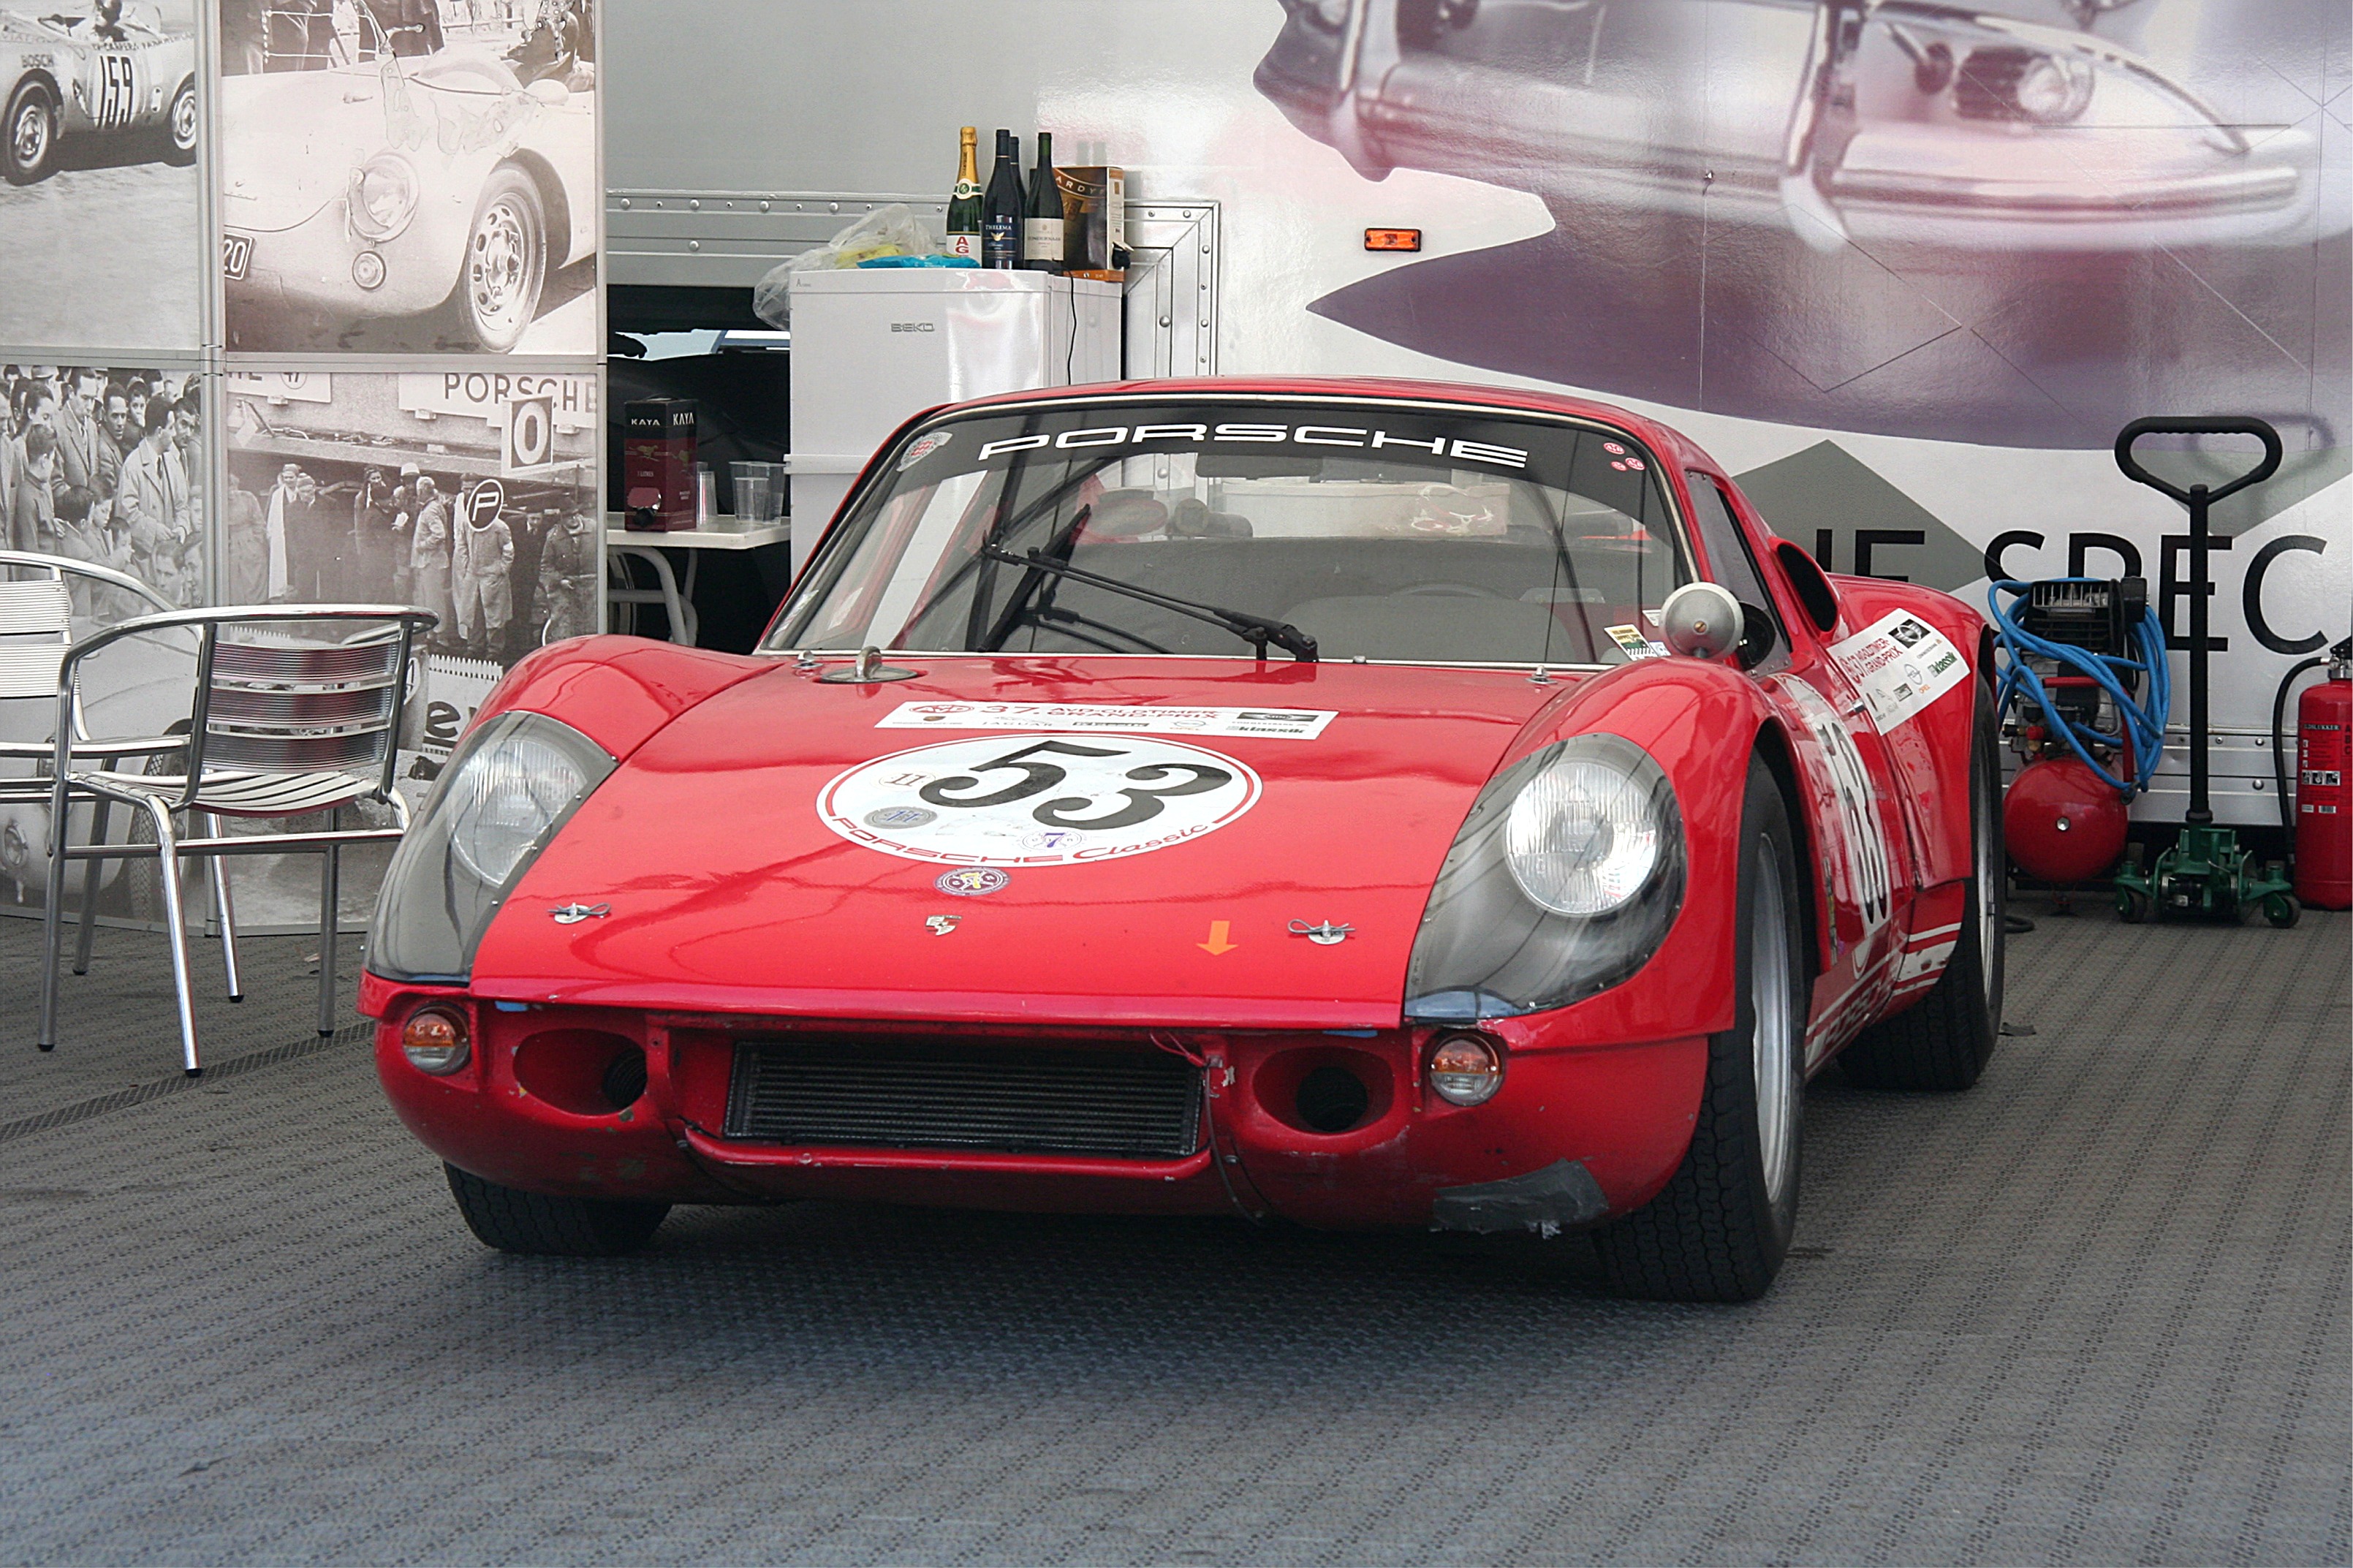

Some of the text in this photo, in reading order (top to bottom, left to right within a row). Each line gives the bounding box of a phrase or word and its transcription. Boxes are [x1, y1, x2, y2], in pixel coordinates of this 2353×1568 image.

[20, 54, 54, 68] BOSCH
[97, 56, 134, 129] 159
[1055, 175, 1106, 195] ARDYS
[890, 322, 936, 333] BEKO
[672, 412, 694, 426] KAYA
[978, 423, 1529, 469] PORSCHE
[1238, 726, 1306, 734] klassik
[919, 741, 1232, 830] 53
[831, 816, 1209, 863] PORSCHE Classic
